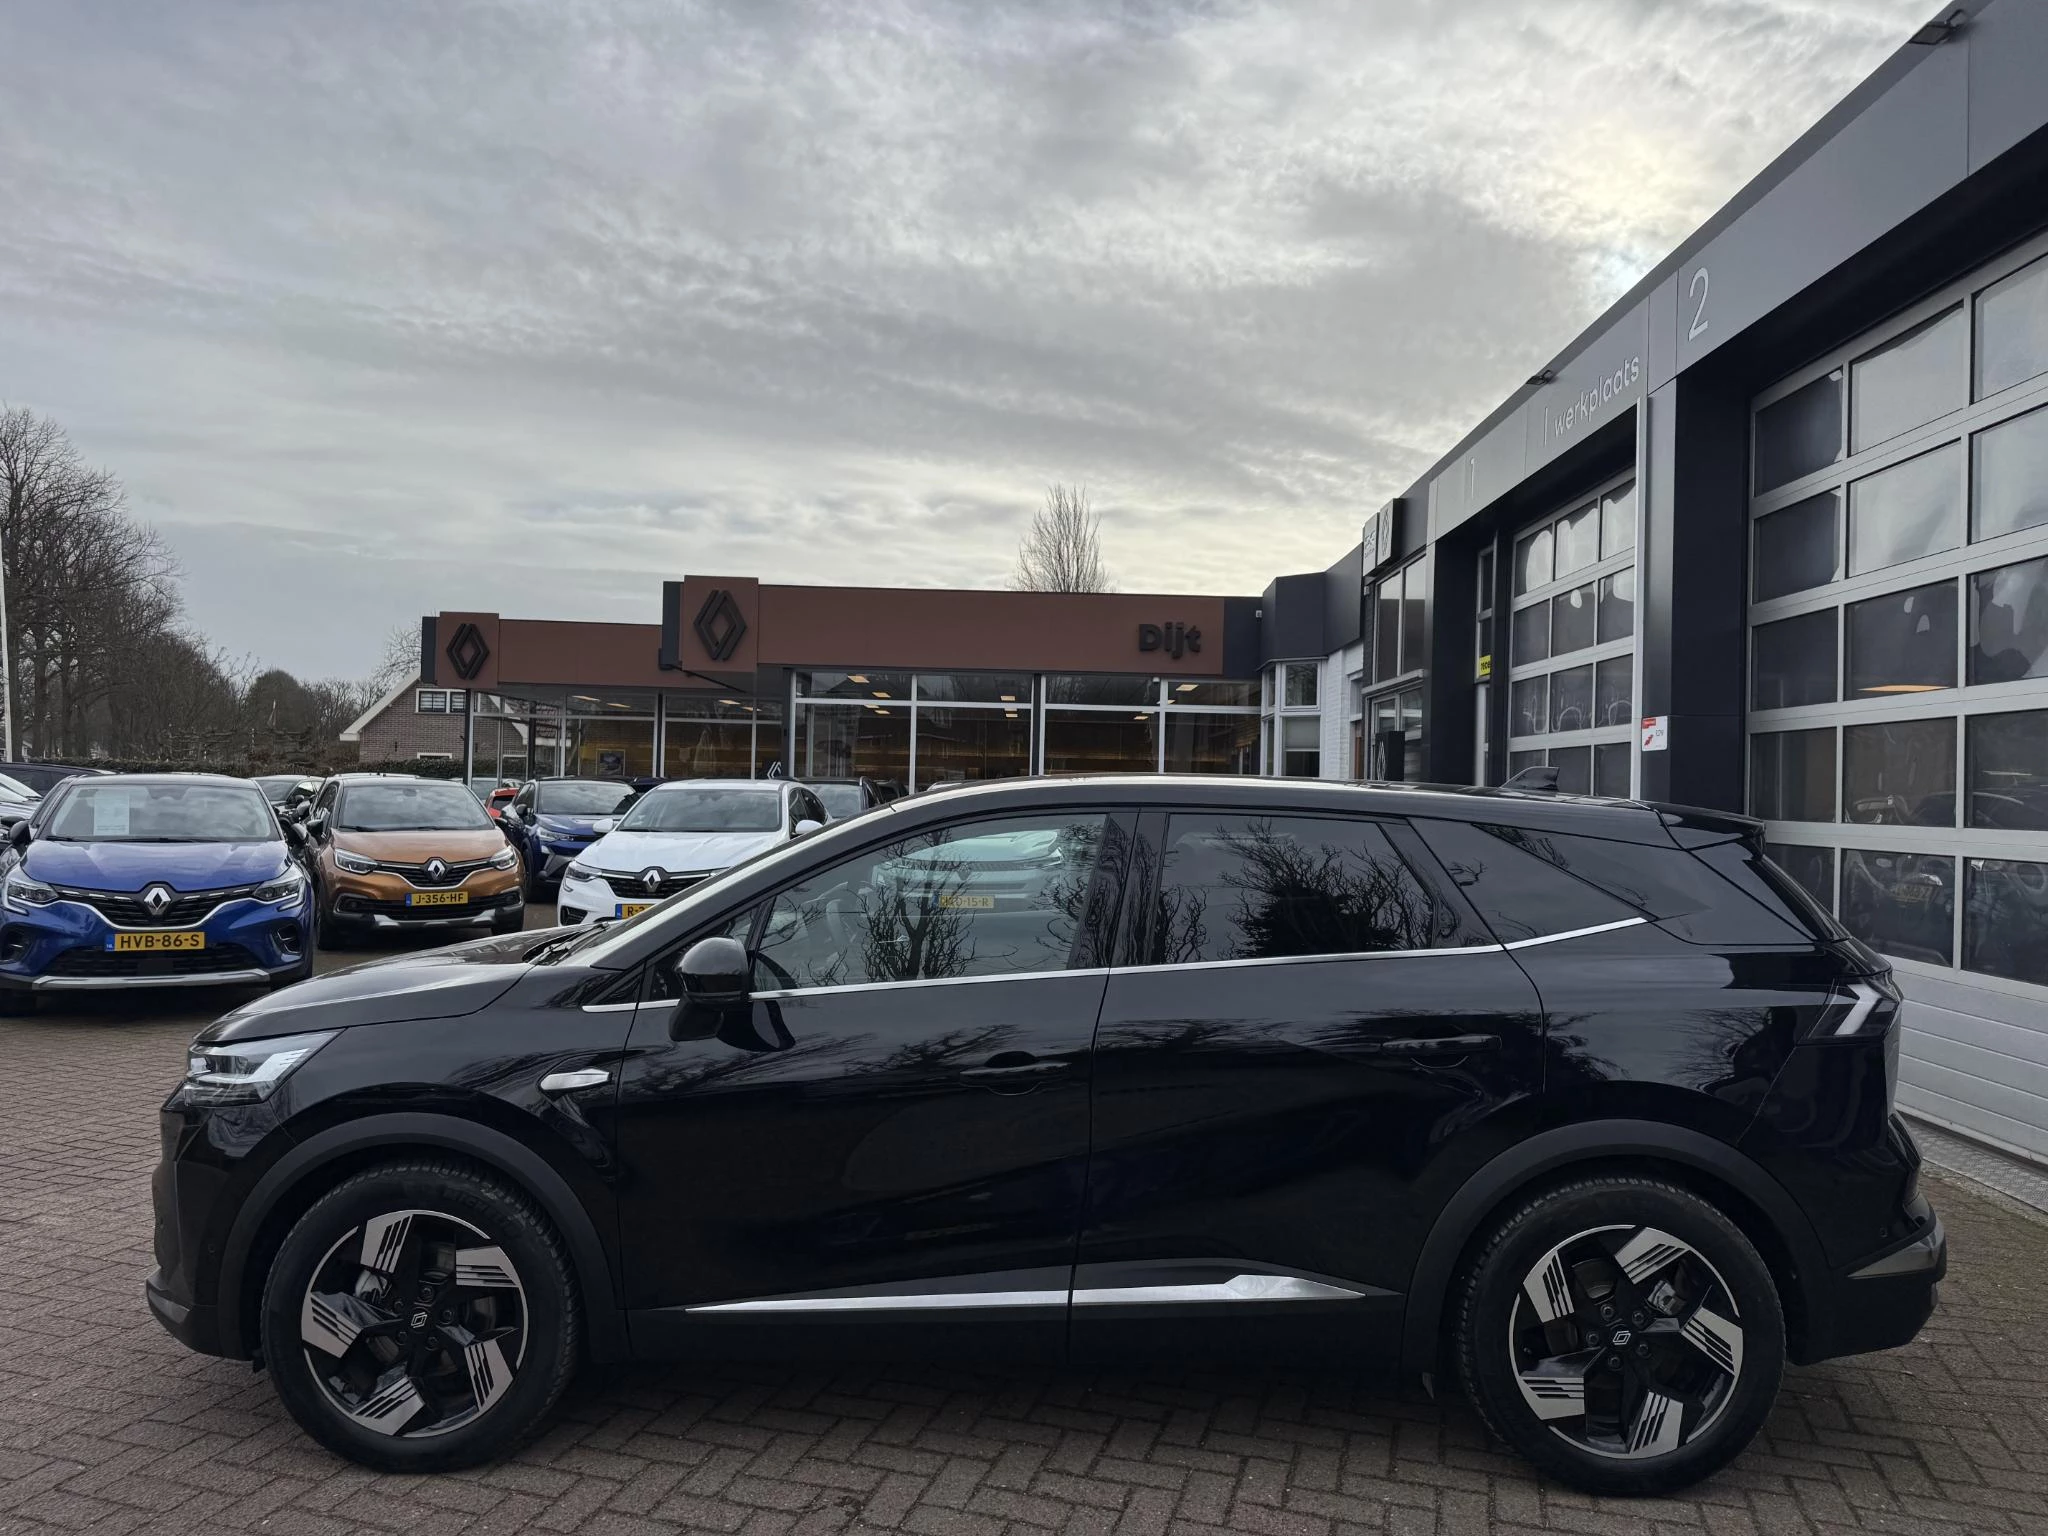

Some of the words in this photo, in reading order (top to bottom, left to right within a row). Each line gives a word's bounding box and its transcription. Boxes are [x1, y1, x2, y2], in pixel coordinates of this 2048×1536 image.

[1688, 267, 1709, 341] 2
[1554, 356, 1640, 438] werkplaats
[1138, 621, 1202, 660] Dijt
[415, 893, 464, 904] J-356-HF
[120, 934, 200, 949] HVB-86-S
